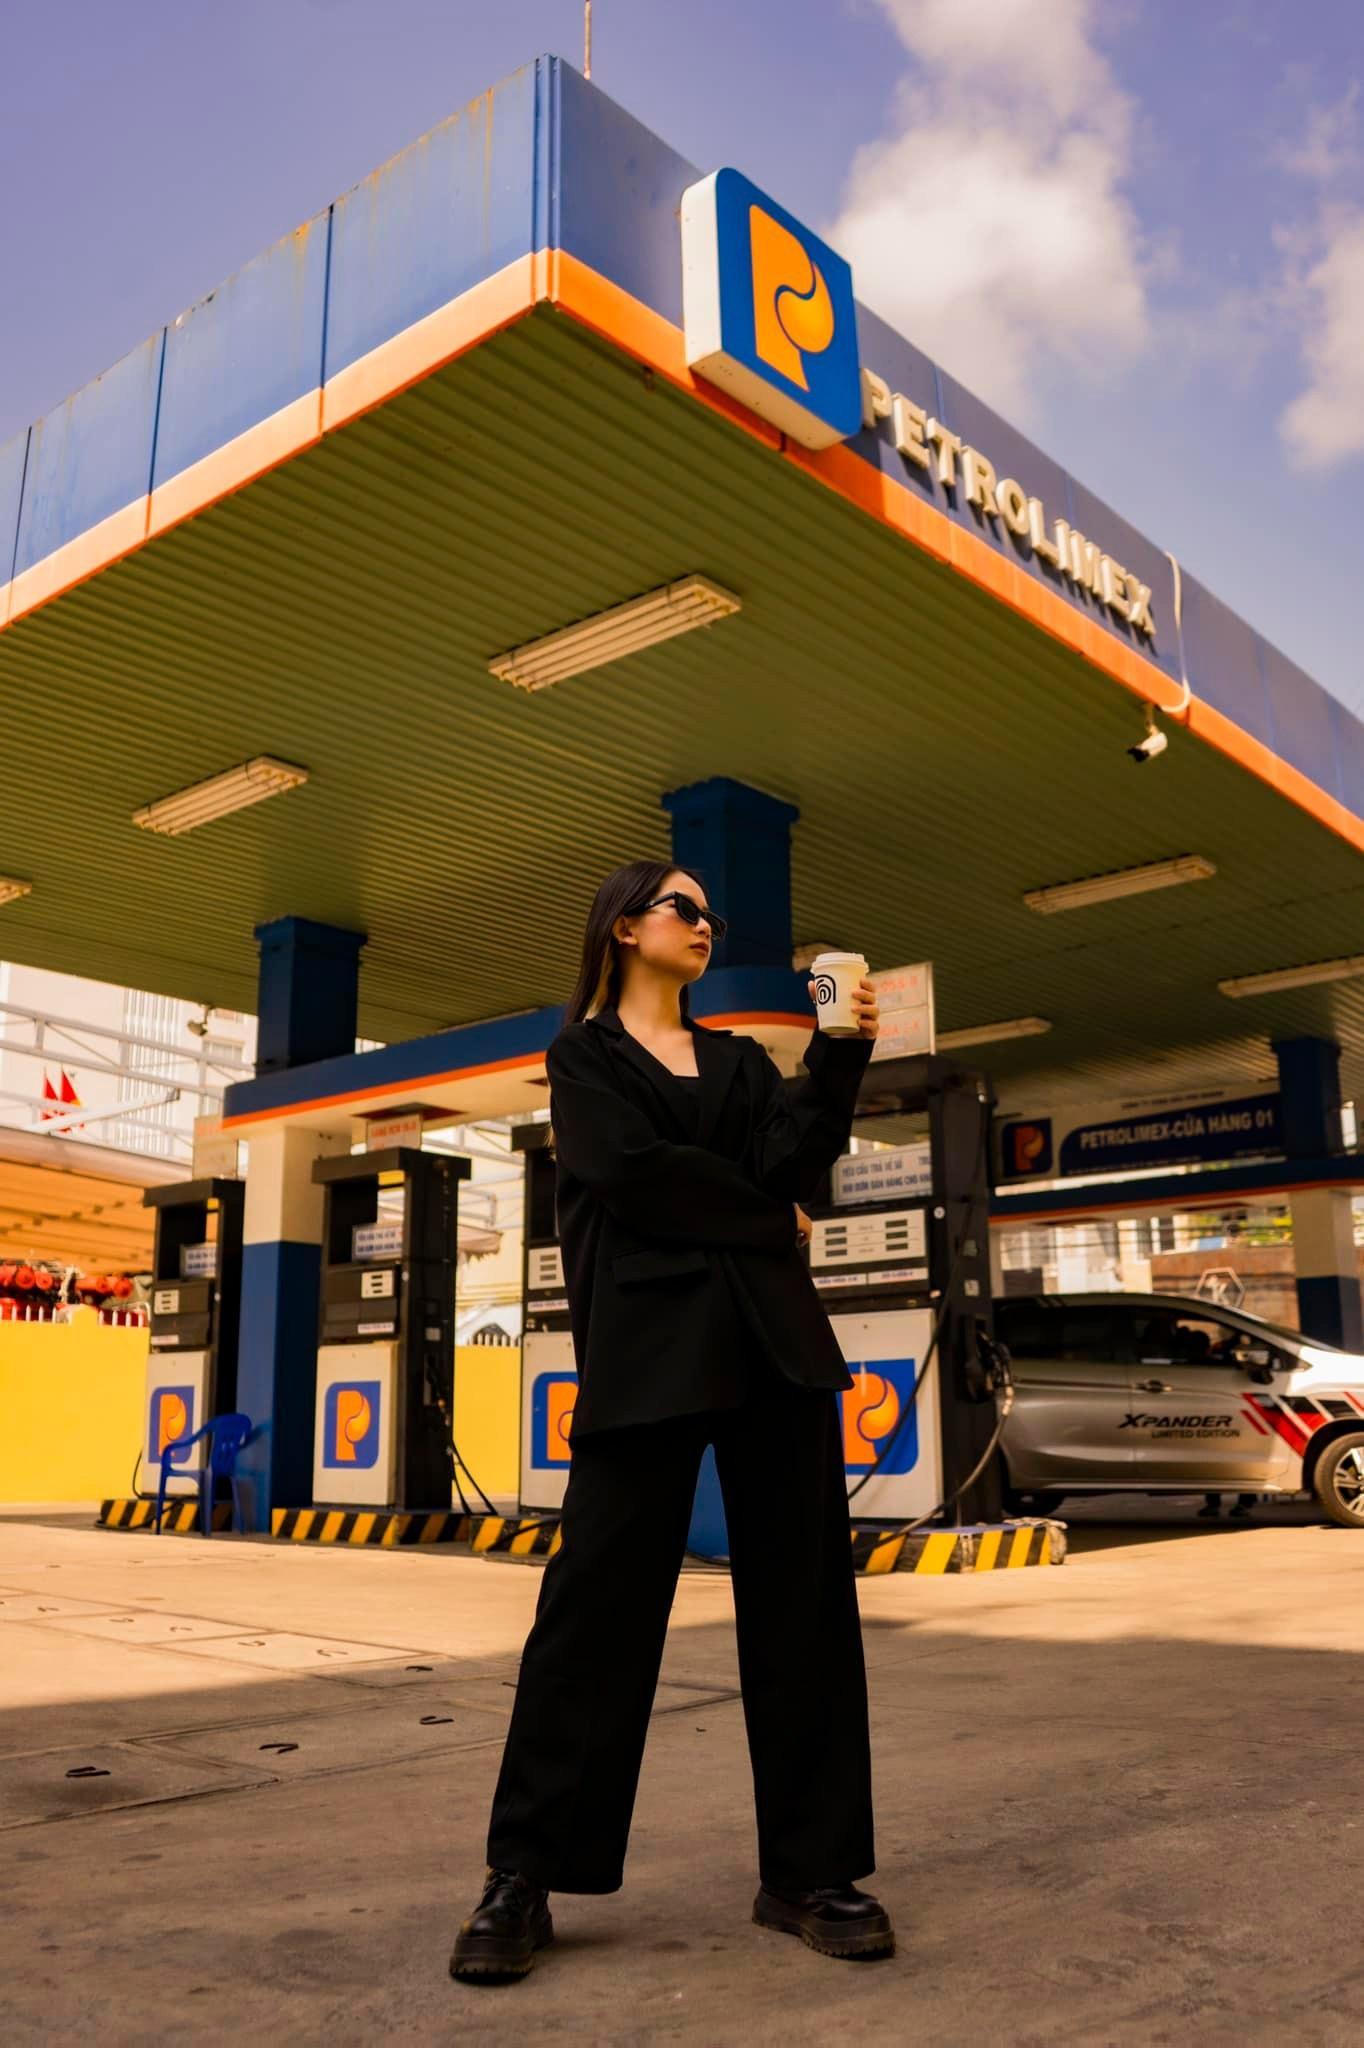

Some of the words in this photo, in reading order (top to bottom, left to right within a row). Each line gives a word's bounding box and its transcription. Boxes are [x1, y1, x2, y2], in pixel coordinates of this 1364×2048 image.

[861, 368, 1156, 636] PETROLIMEX
[1256, 1109, 1273, 1127] 01
[1119, 1413, 1232, 1428] XPANDER
[1152, 1430, 1193, 1439] LIMITED
[1197, 1429, 1240, 1438] EDITION
